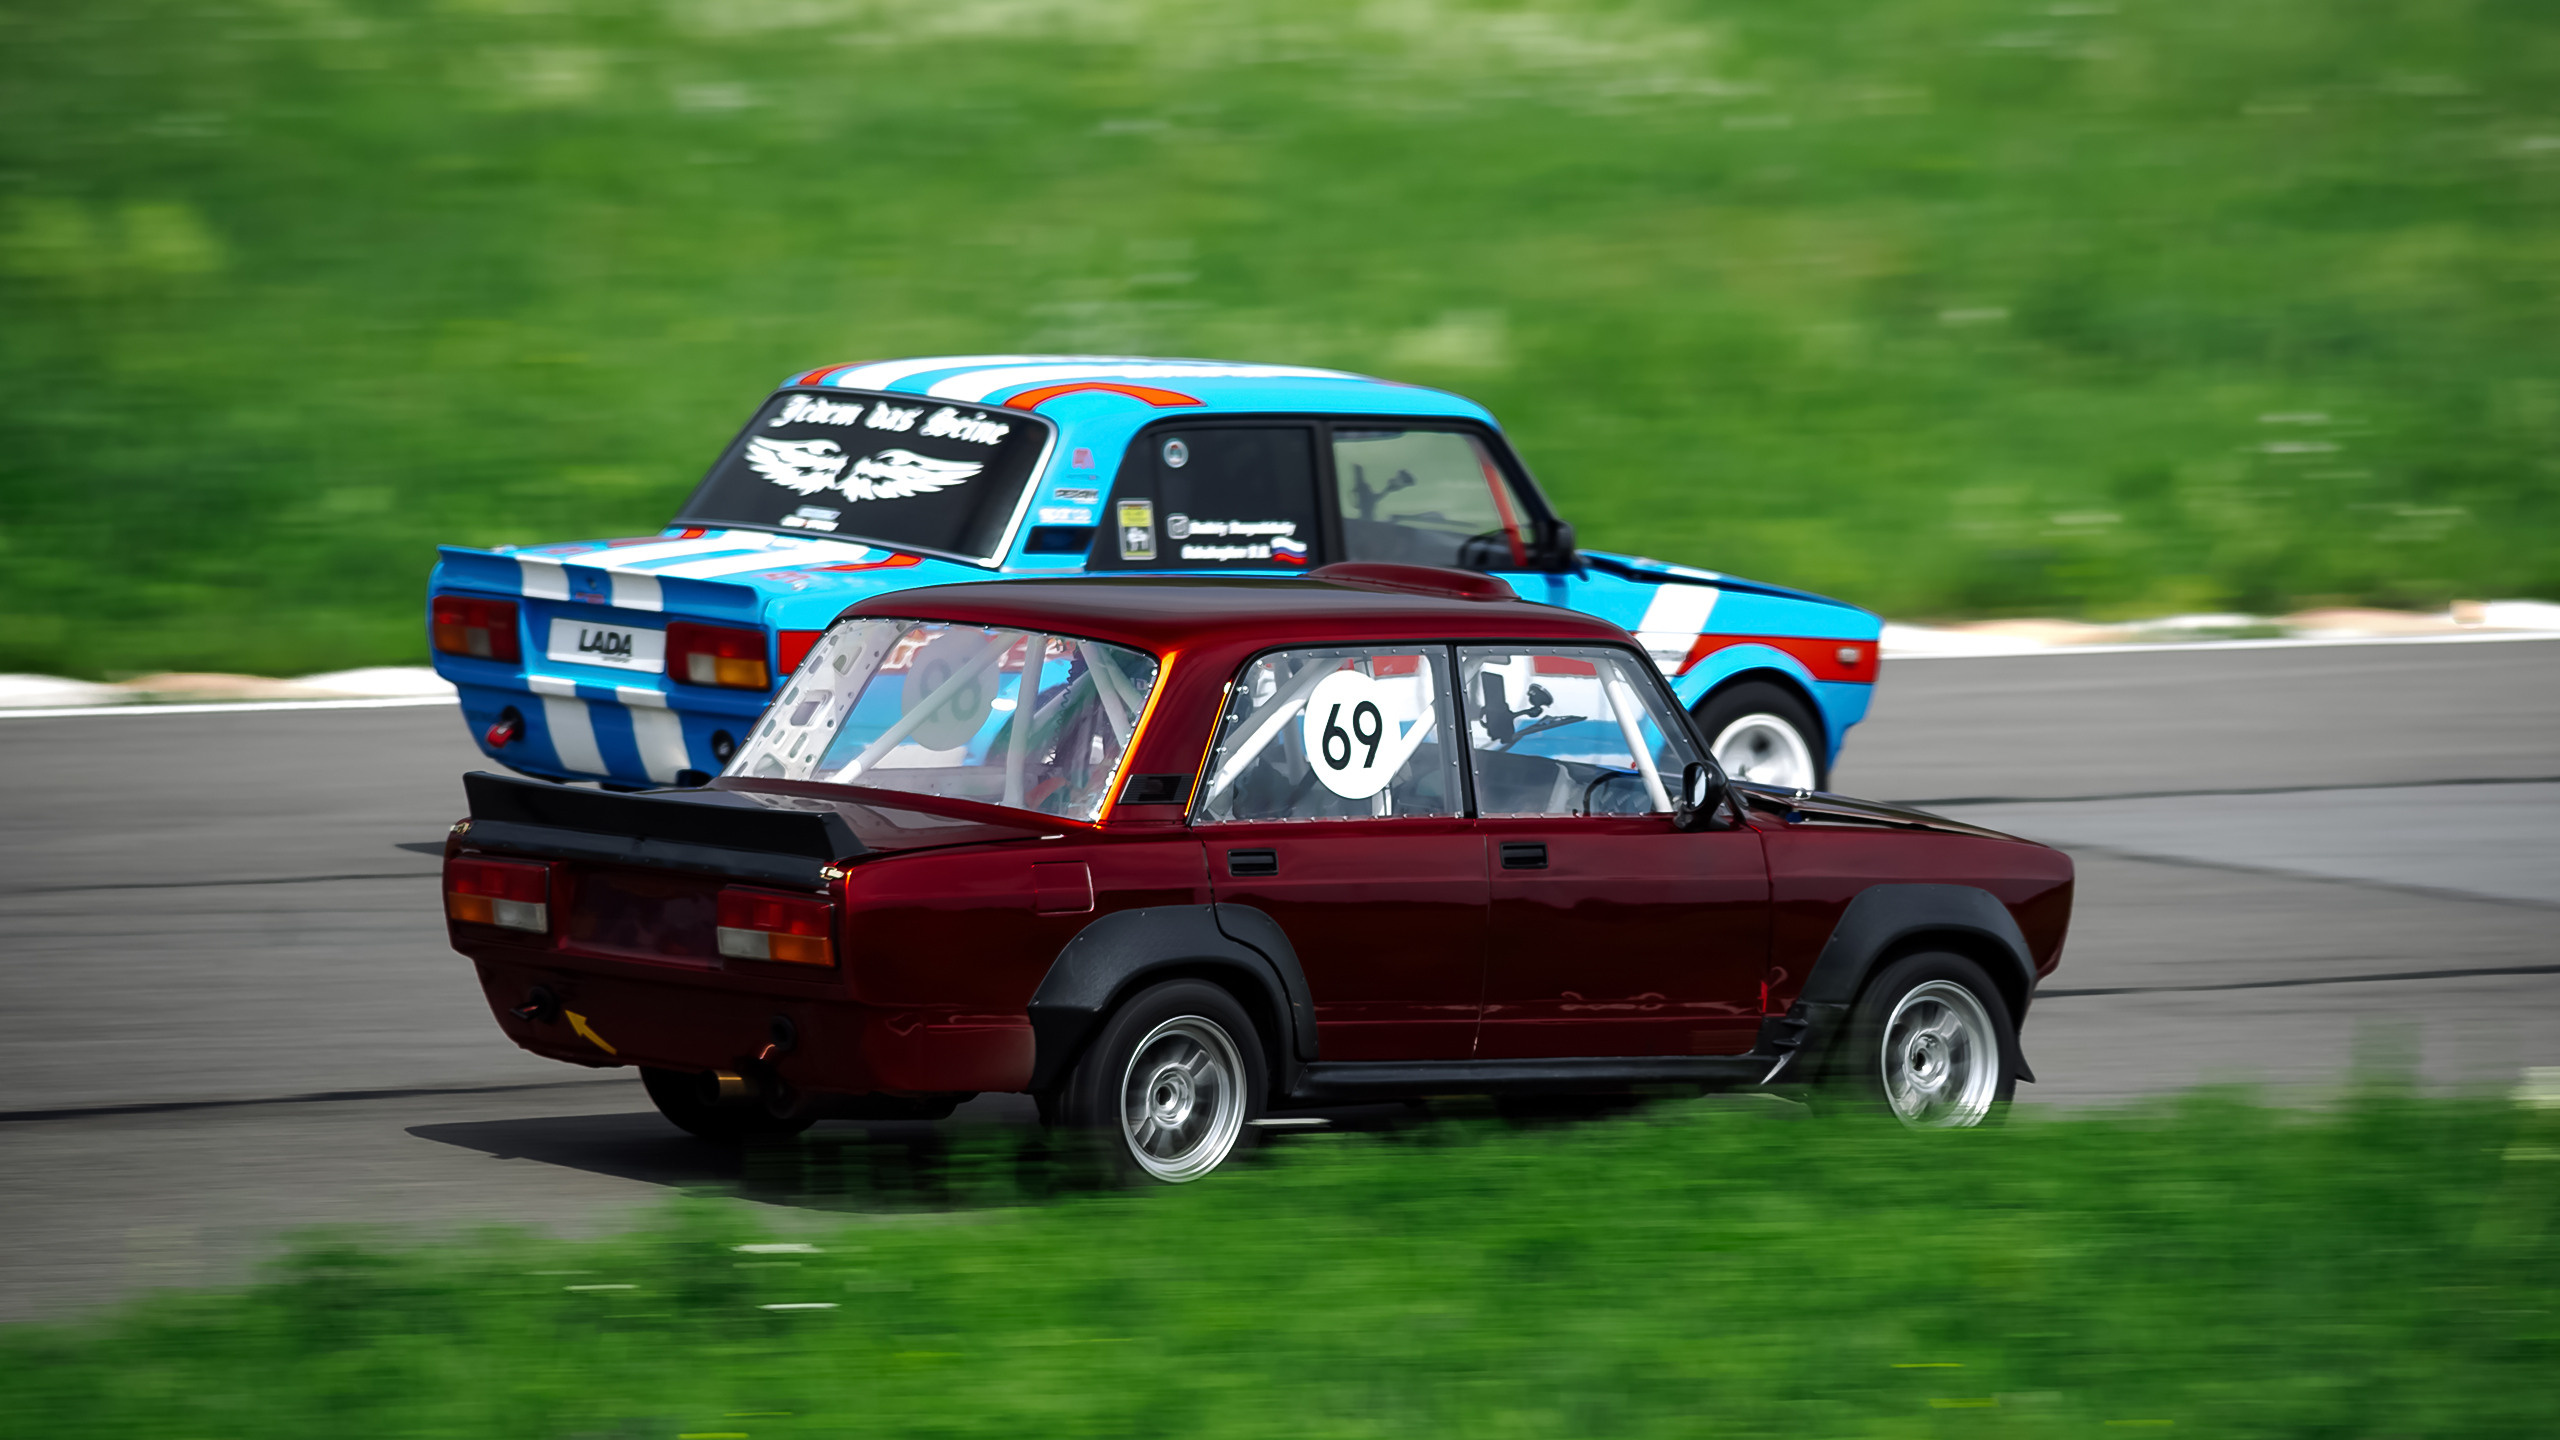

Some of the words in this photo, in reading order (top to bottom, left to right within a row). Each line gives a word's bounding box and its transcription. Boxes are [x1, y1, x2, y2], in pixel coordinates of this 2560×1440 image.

[865, 401, 924, 432] das
[579, 629, 632, 657] LADA
[1322, 700, 1383, 770] 69
